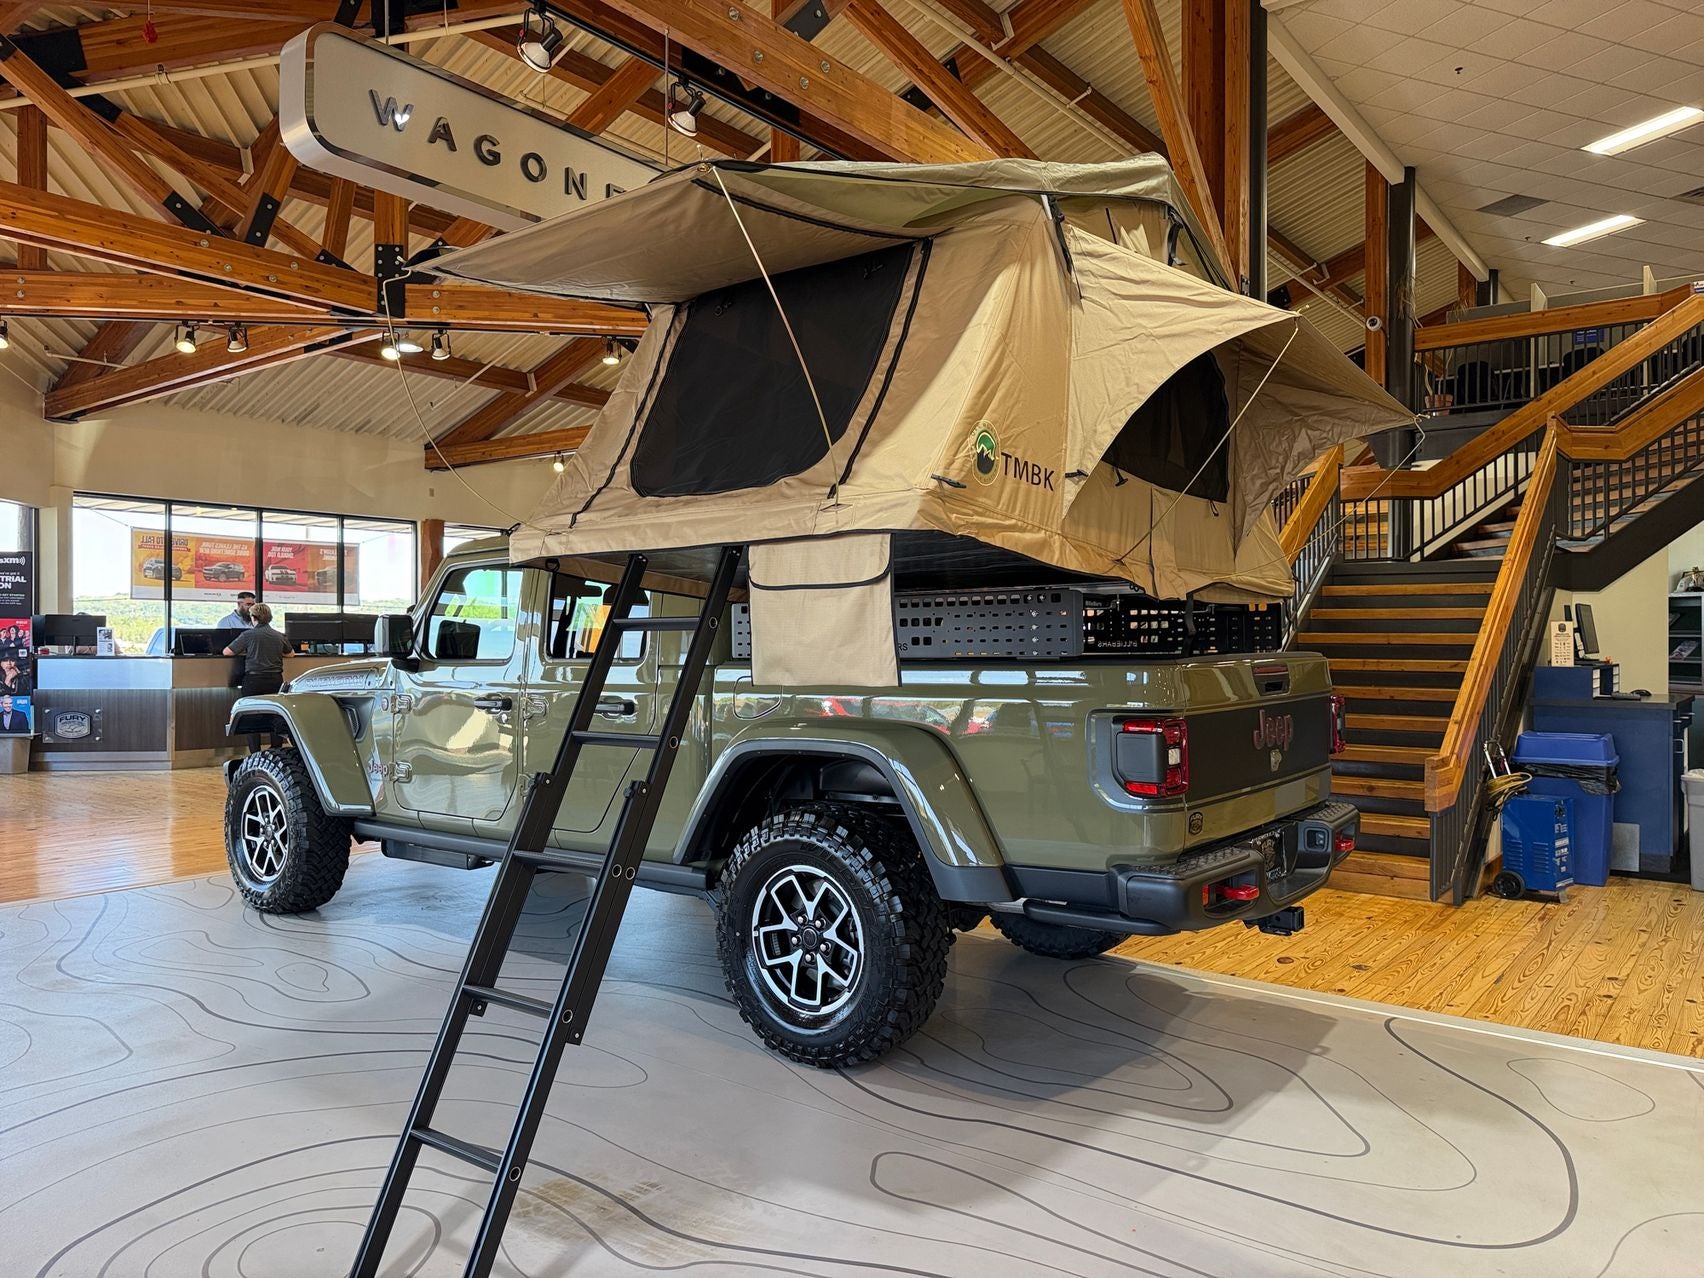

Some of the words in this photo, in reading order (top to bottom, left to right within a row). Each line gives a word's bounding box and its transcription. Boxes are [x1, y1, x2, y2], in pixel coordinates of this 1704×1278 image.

[1000, 451, 1055, 492] TMBK
[0, 575, 27, 583] TRIAL
[59, 714, 86, 723] FURY
[1253, 709, 1294, 752] Jeep
[367, 758, 388, 776] Jeep
